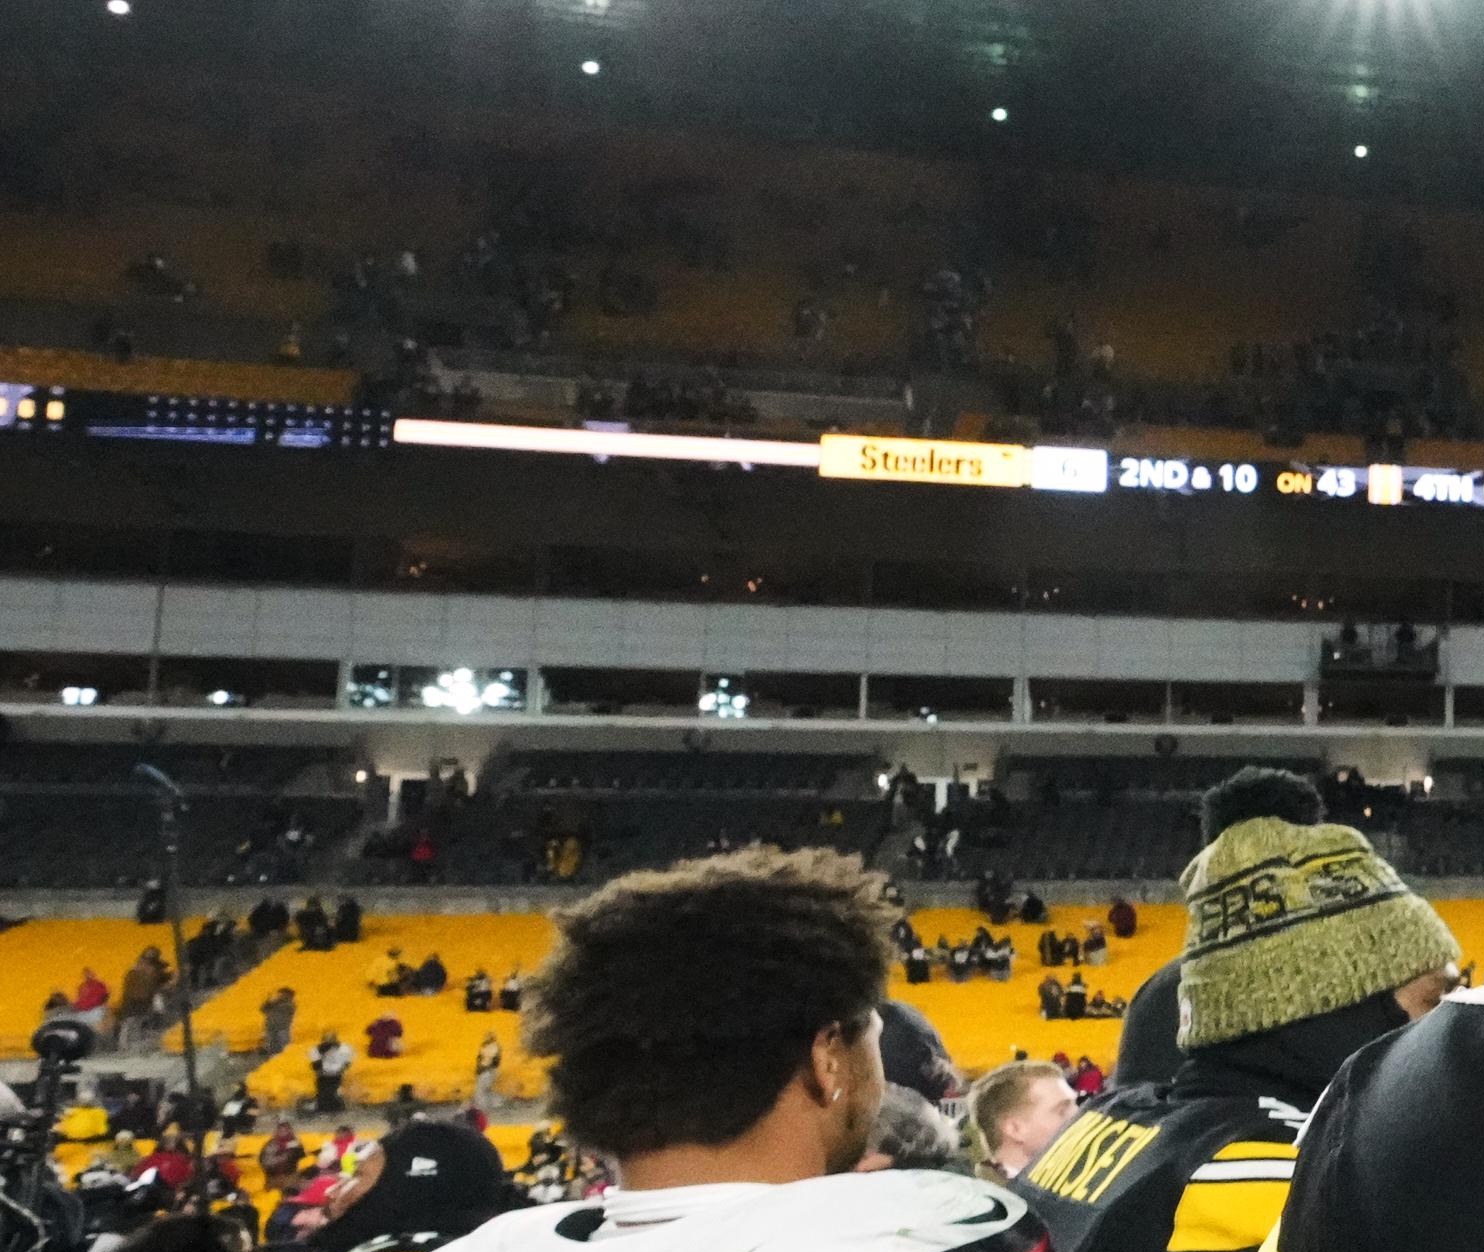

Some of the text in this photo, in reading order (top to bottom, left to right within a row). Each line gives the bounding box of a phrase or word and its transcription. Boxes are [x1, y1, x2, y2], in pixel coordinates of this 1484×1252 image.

[860, 444, 983, 477] Steelers
[1119, 457, 1189, 490] 2ND
[1218, 463, 1258, 493] 10
[1276, 469, 1356, 498] ON 43
[1413, 473, 1474, 503] 4TH
